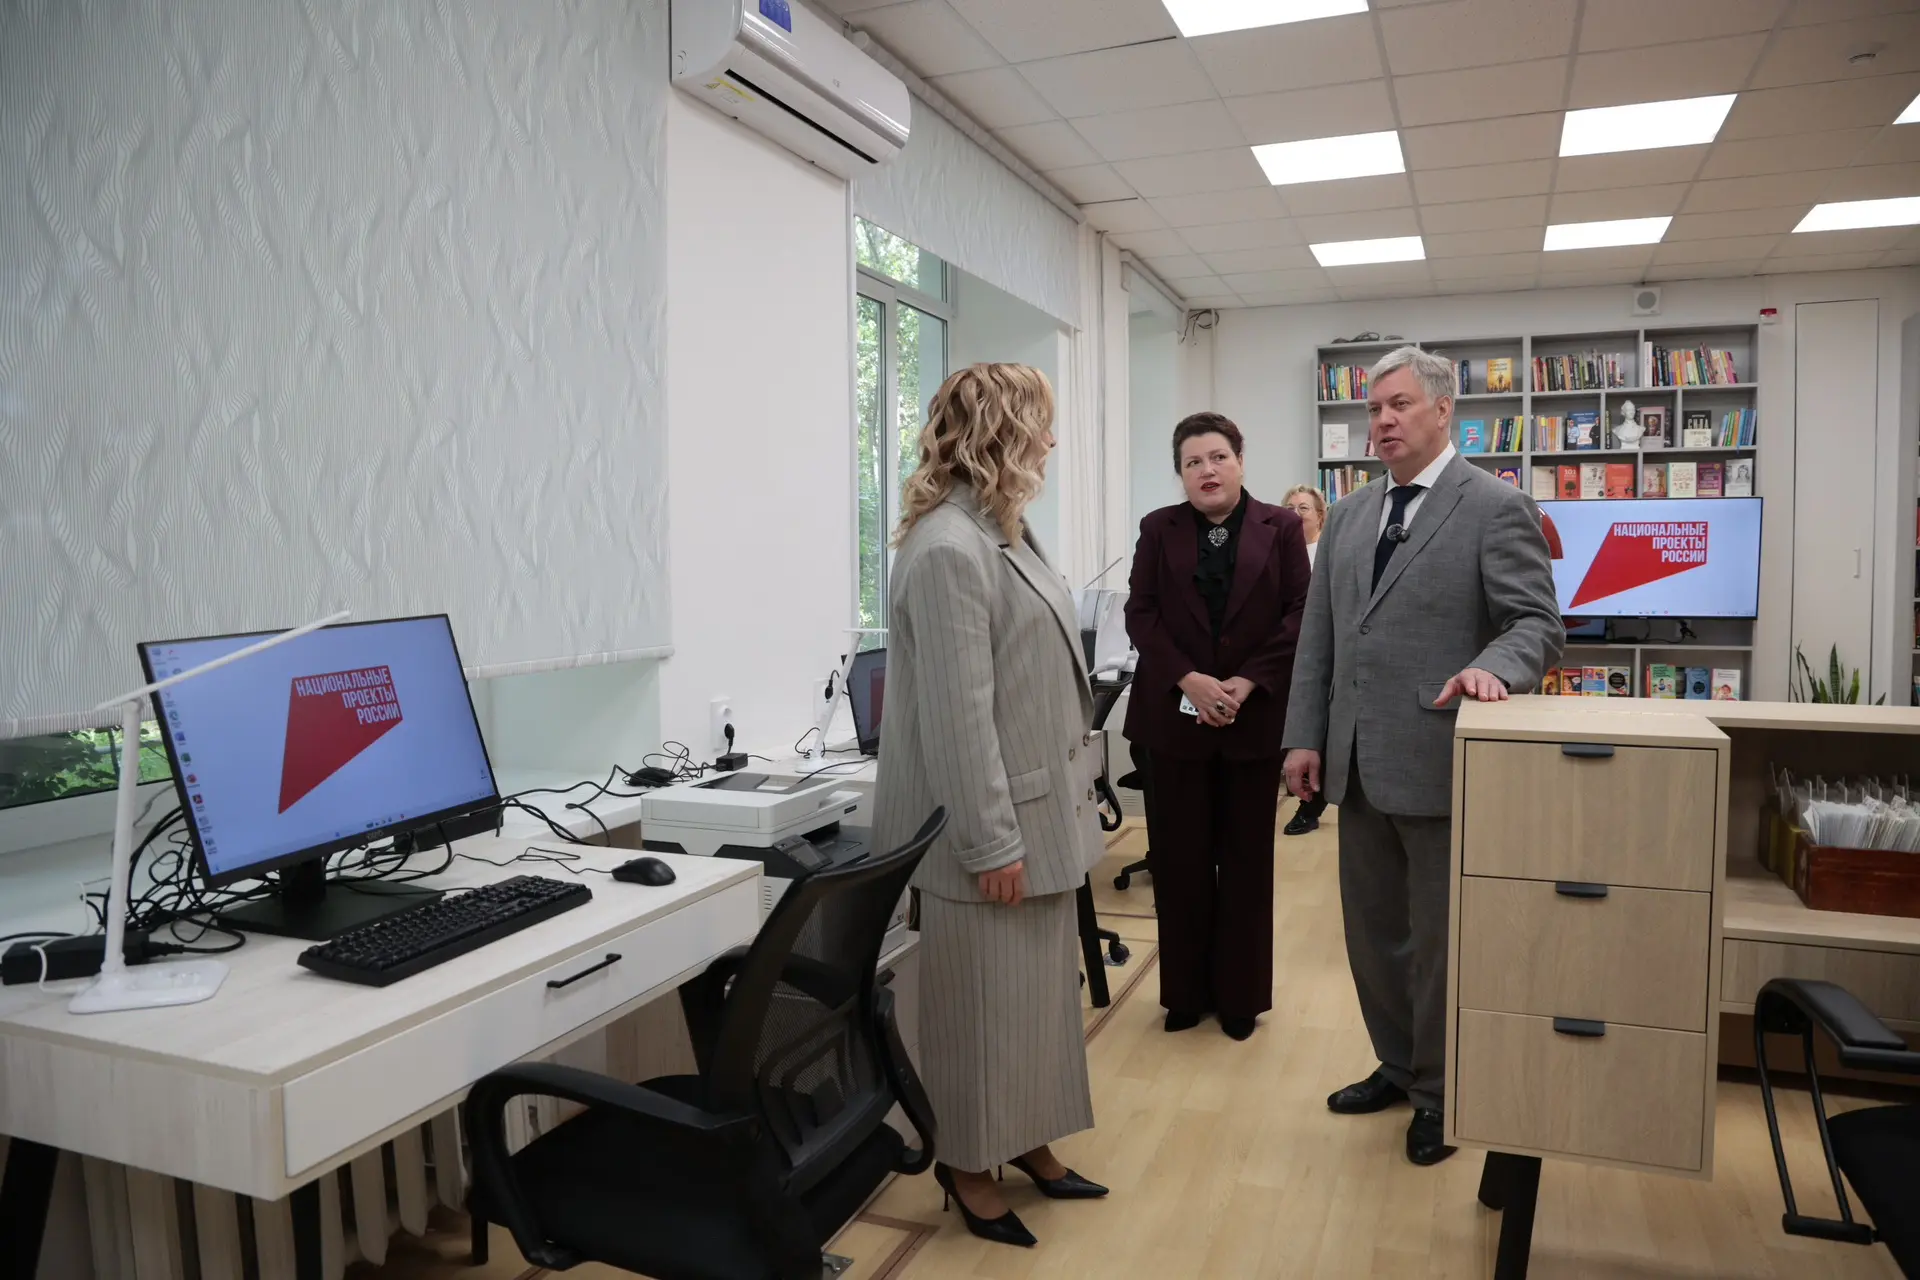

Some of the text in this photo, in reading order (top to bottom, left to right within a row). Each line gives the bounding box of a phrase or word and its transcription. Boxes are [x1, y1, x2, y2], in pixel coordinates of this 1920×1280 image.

[1613, 523, 1707, 538] НАЦИОНАЛЬНЫЕ
[1652, 537, 1706, 549] ПРОЕКТЫ
[1661, 550, 1705, 562] РОССИИ
[295, 668, 391, 697] НАЦИОНАЛЬНЫЕ
[341, 686, 396, 709] ПРОЕКТЫ
[356, 702, 401, 725] РОССИИ
